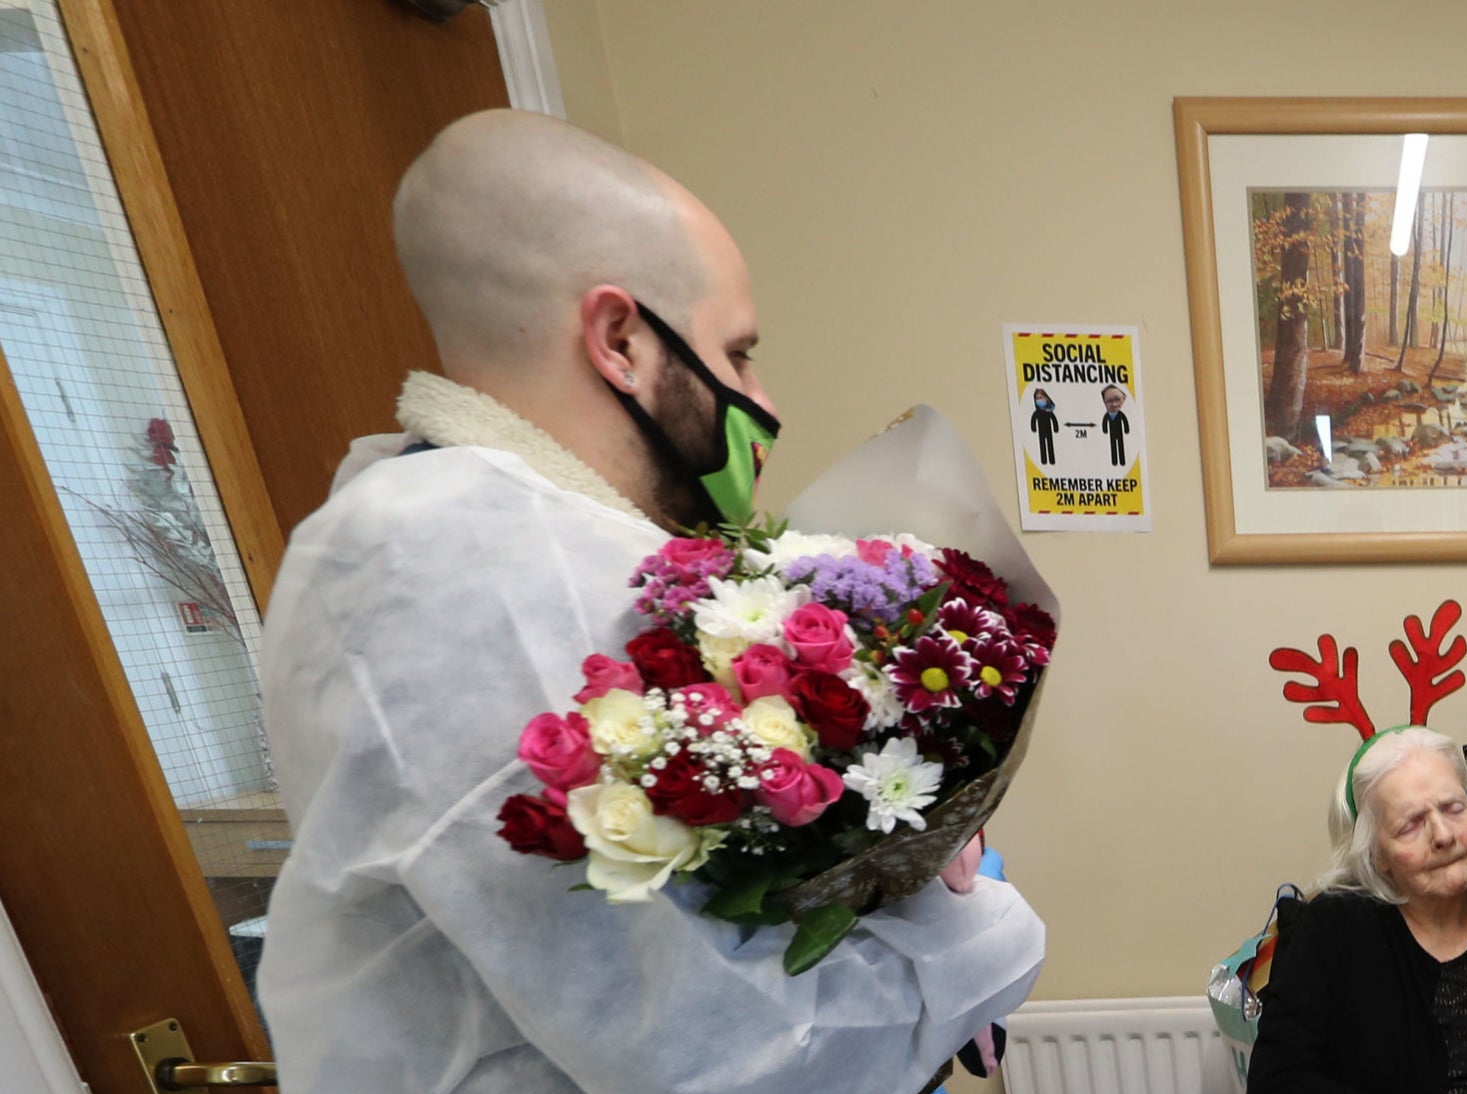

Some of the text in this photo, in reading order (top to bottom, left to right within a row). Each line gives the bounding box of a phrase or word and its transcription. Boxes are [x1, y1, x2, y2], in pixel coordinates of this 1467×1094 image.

[1042, 343, 1106, 363] SOCIAL
[1023, 364, 1128, 384] DISTANCING
[1075, 429, 1087, 439] 2M
[1032, 477, 1137, 492] REMEMBER KEEP
[1056, 493, 1117, 507] 2M APART
